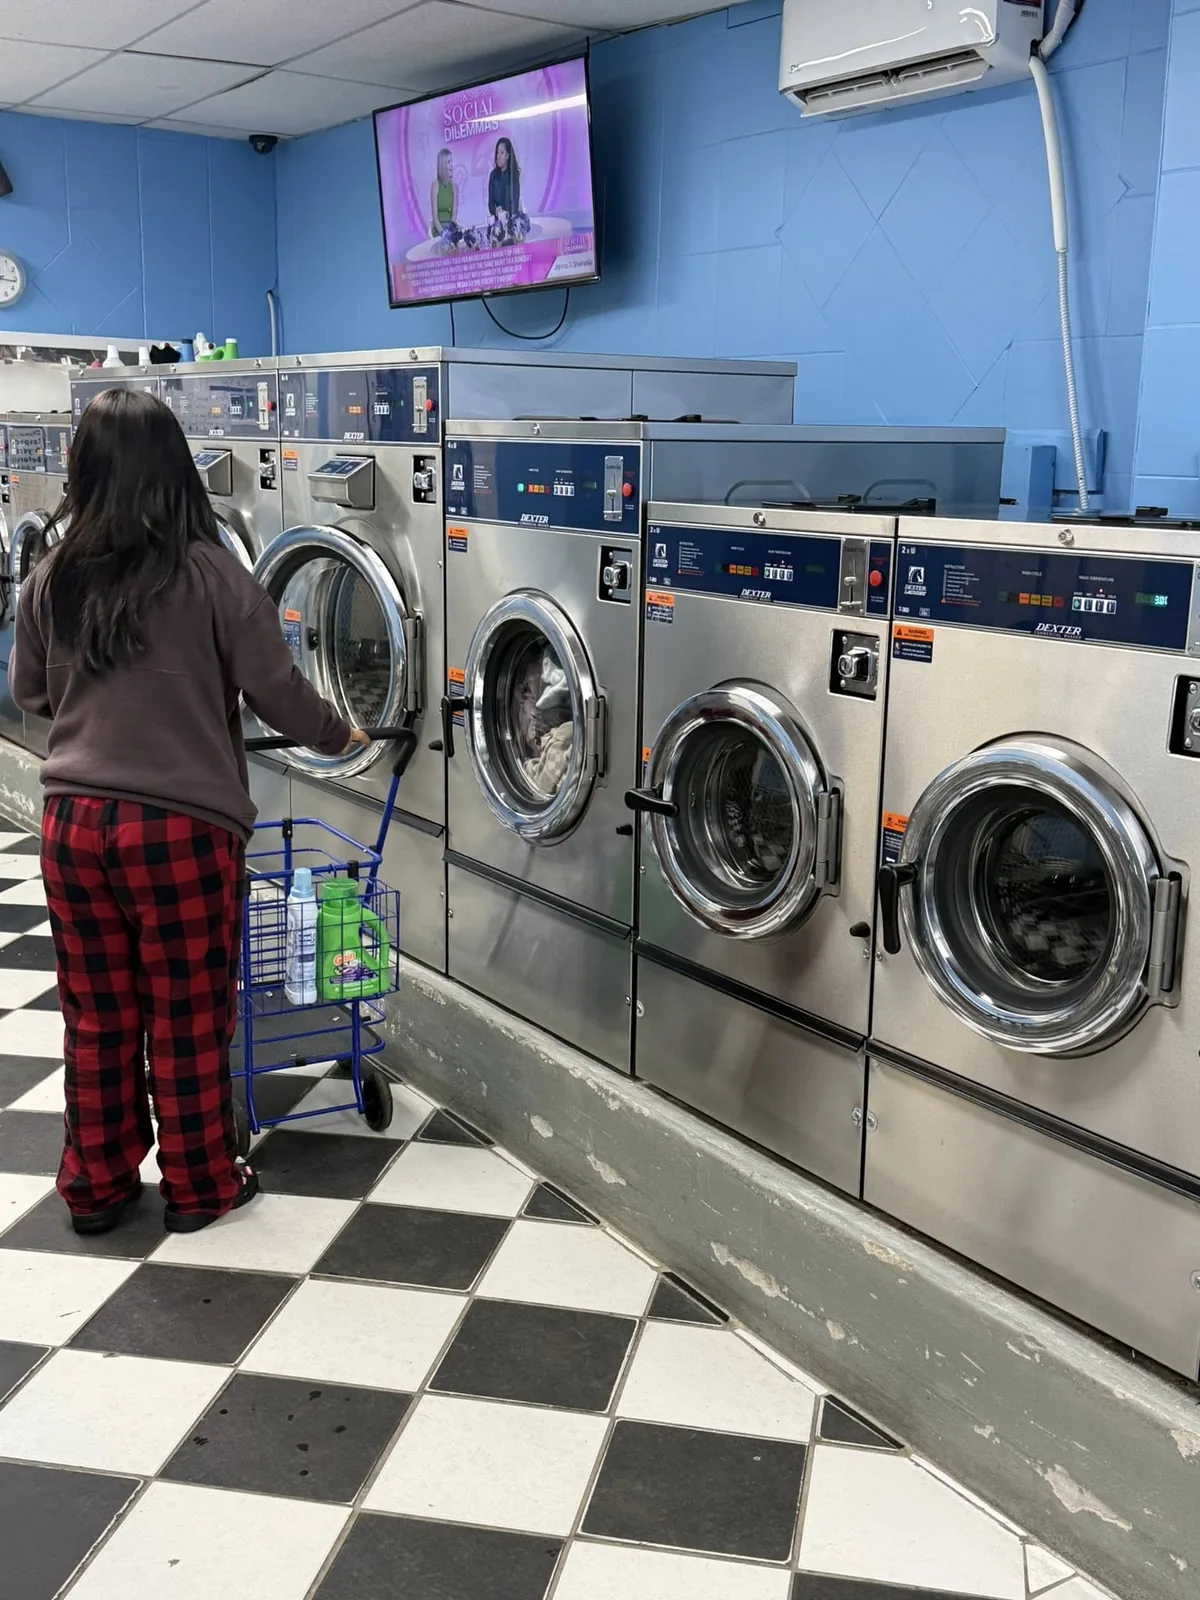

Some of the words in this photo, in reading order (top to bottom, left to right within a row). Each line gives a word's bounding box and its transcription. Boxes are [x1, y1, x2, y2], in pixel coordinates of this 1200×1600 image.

[444, 97, 498, 125] SOCIAL
[444, 121, 498, 142] DILEMMAS
[344, 432, 364, 440] DEXTER
[520, 514, 549, 523] DEXTER
[741, 589, 771, 599] DEXTER
[1036, 623, 1082, 635] DEXTER
